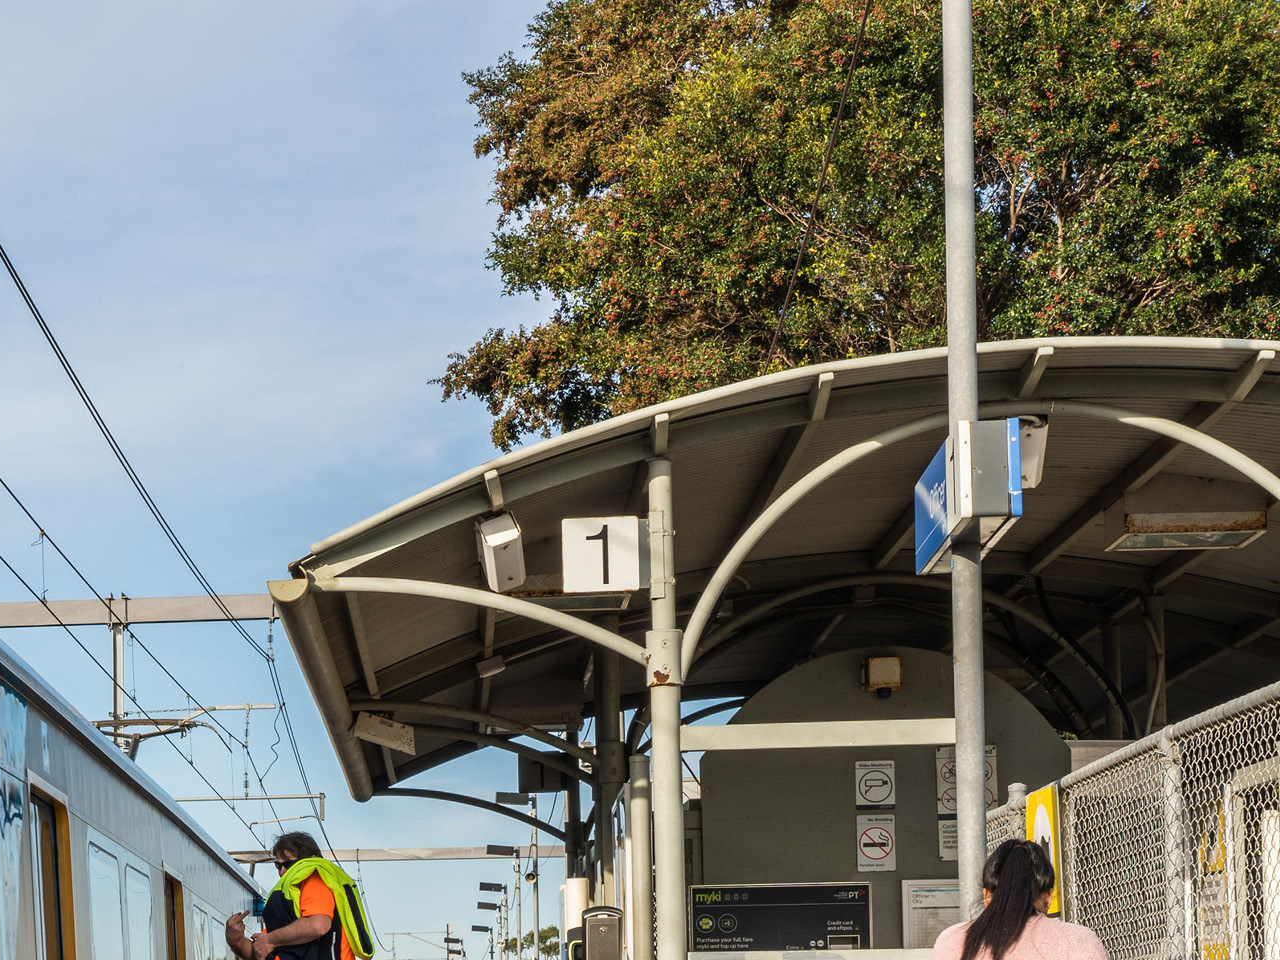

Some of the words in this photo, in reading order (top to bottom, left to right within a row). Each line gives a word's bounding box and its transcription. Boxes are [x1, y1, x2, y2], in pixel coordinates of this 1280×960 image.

[586, 525, 609, 584] 1
[696, 891, 722, 904] myki
[848, 891, 860, 899] PT
